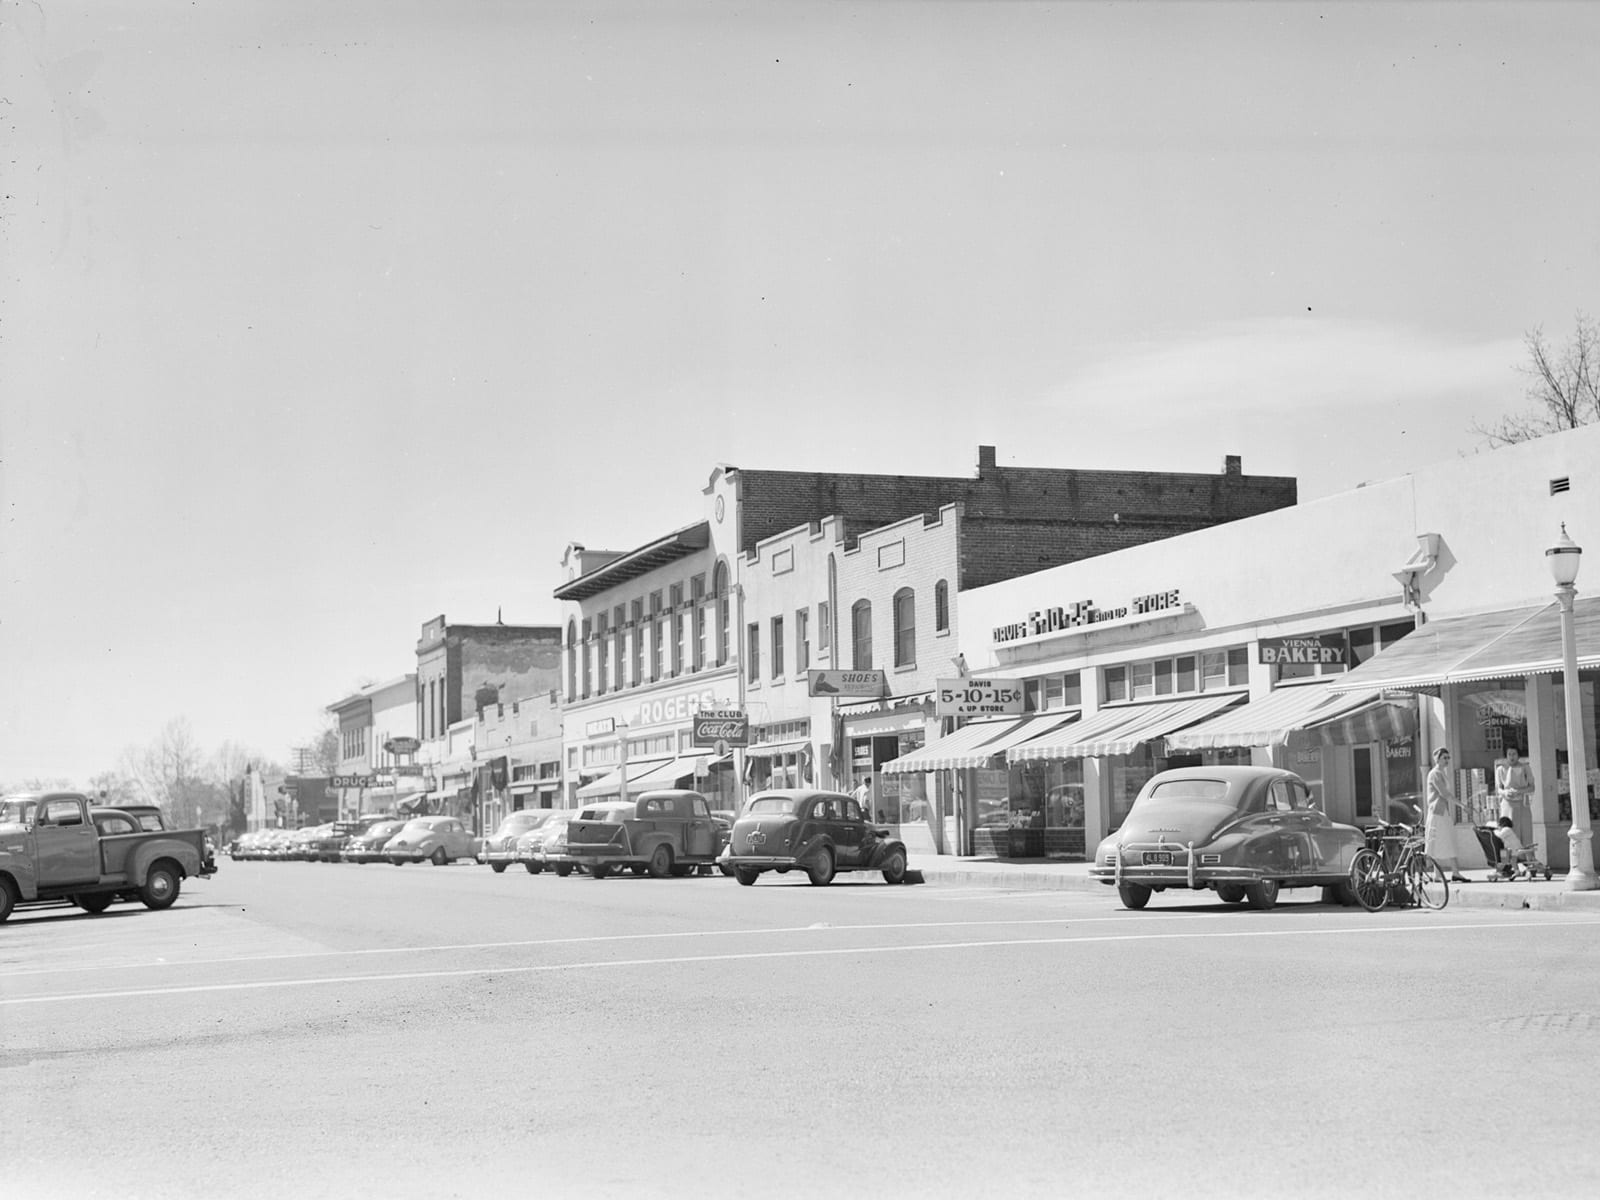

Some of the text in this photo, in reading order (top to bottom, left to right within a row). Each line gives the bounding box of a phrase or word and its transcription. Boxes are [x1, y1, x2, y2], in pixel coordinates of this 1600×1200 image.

[993, 622, 1027, 643] DAVIS
[1115, 607, 1128, 619] UP
[1132, 589, 1181, 614] STORE
[1282, 639, 1322, 647] VIENNA
[1262, 647, 1344, 663] BAKERY
[841, 673, 879, 683] SHOES
[968, 680, 992, 688] DAVIS
[941, 689, 1021, 703] 5-10-15¢
[640, 690, 714, 724] ROGERS
